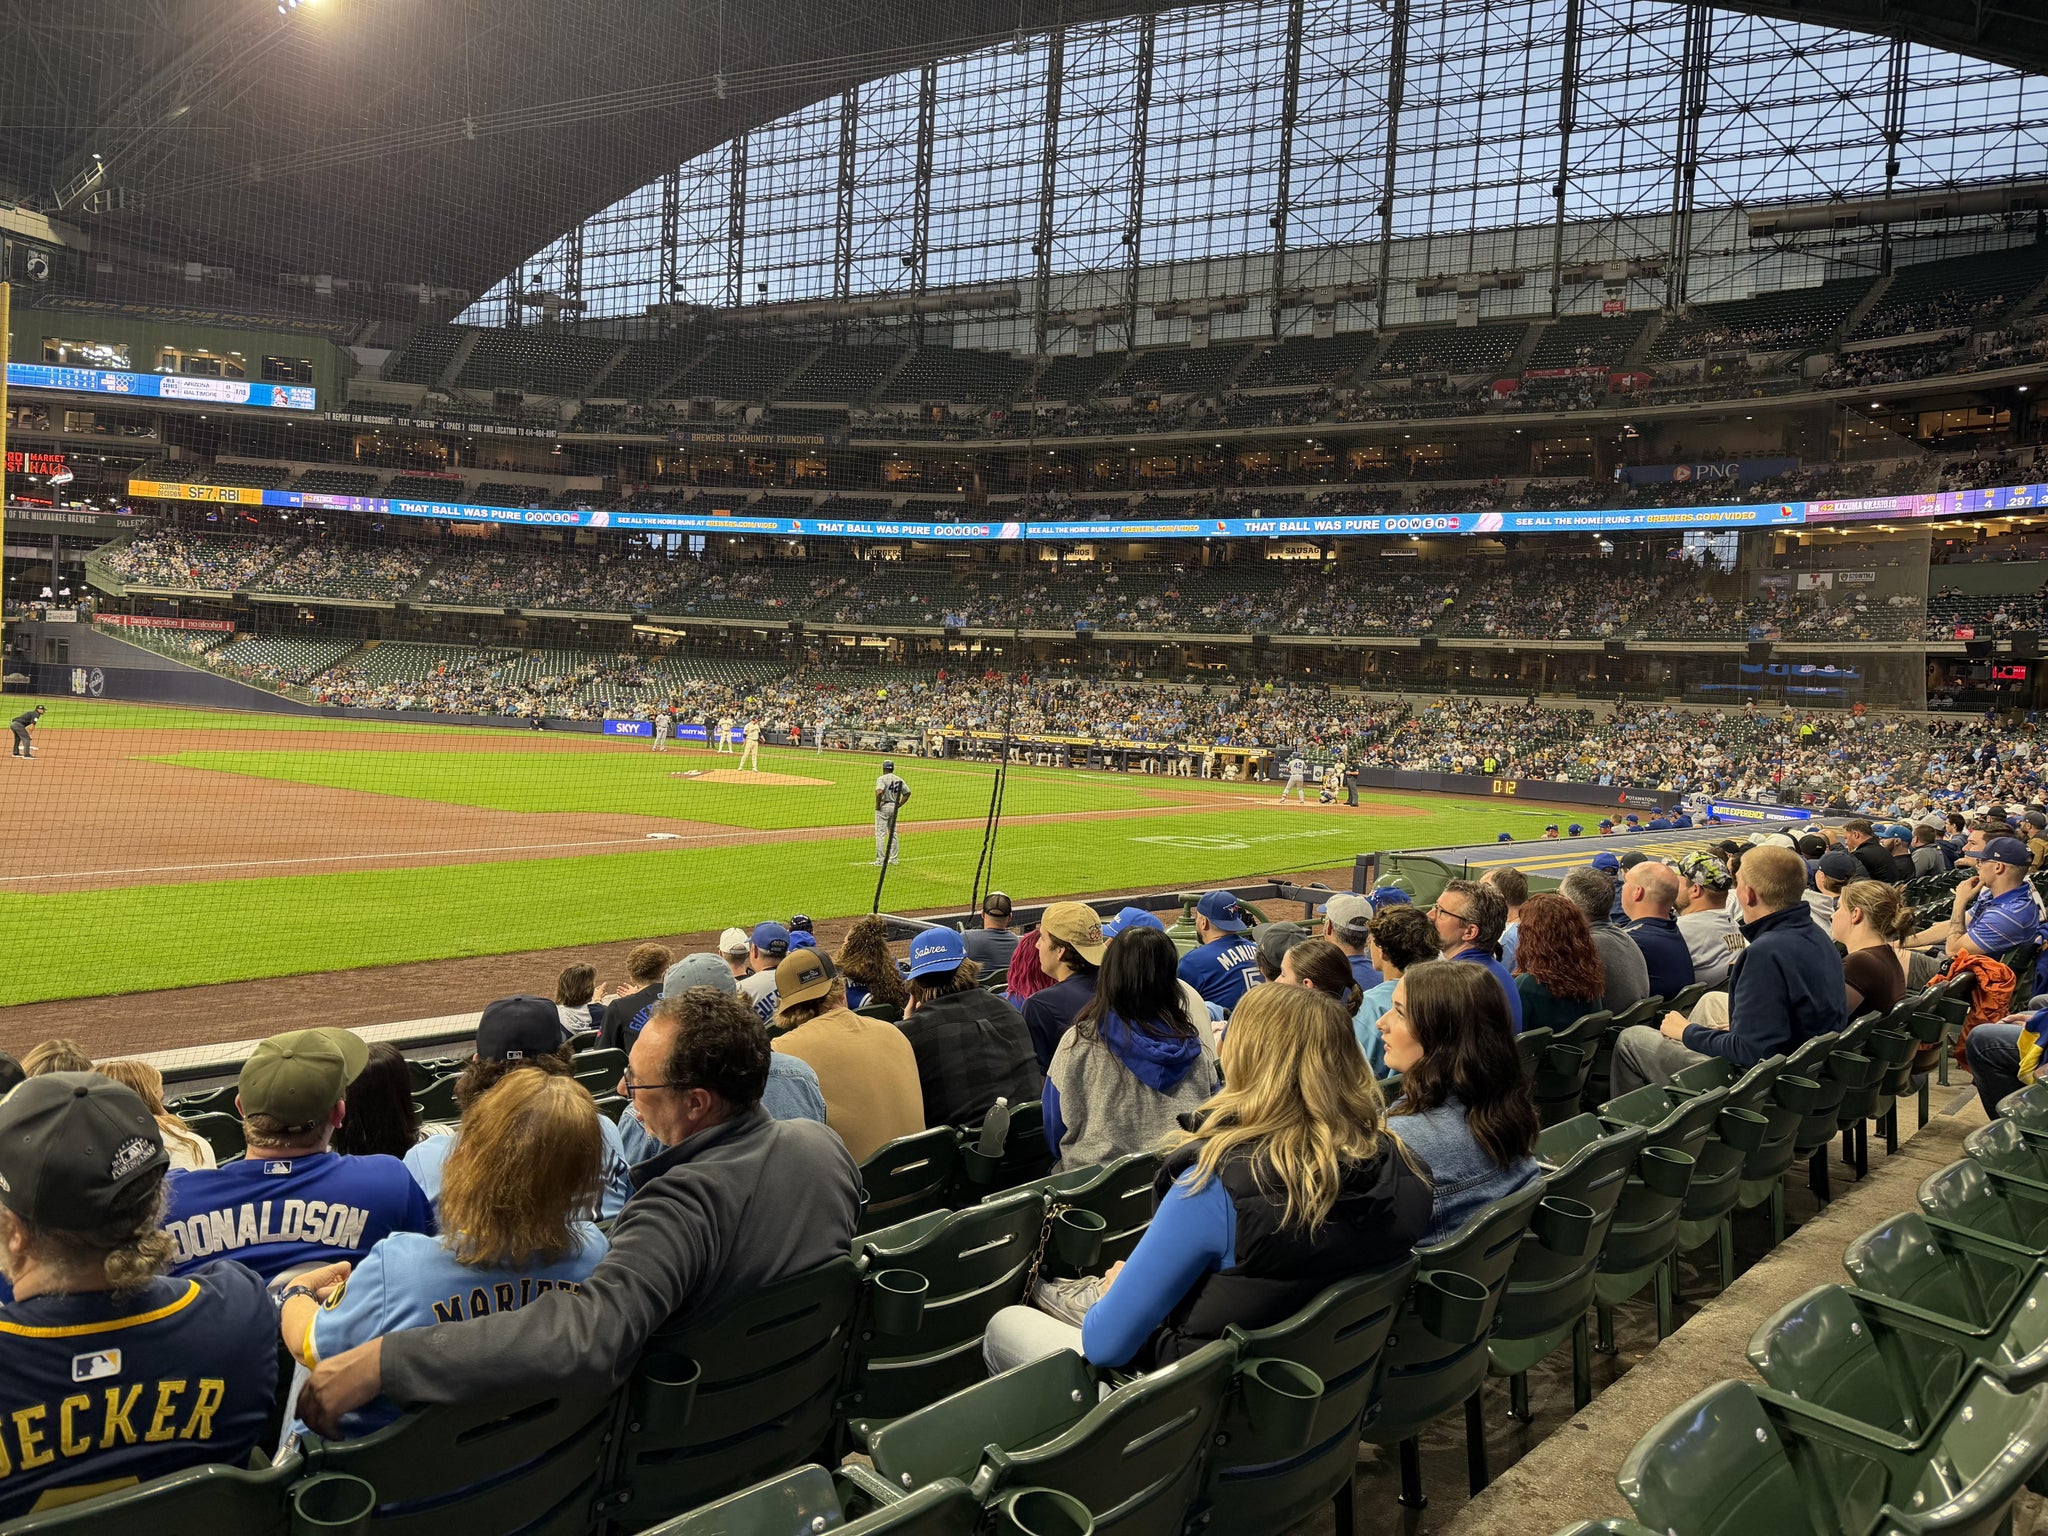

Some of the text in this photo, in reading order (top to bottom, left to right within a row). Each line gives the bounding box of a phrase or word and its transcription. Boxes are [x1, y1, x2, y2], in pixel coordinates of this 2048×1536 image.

[62, 299, 119, 310] MUST
[124, 304, 149, 312] BE
[152, 307, 176, 315] IN
[178, 309, 218, 319] THE
[220, 313, 288, 326] FRONT
[183, 390, 217, 398] BALTIMORE
[332, 413, 351, 422] REPORT
[352, 413, 362, 422] FAN
[398, 417, 410, 427] TEXT
[468, 423, 482, 432] ISSUE
[484, 424, 494, 433] AND
[495, 424, 517, 436] LOCATION
[692, 433, 824, 444] BREWERS COMMUNITY FOUNDATION
[30, 453, 65, 463] MARKET
[1696, 464, 1739, 480] PNC
[158, 483, 181, 491] SCORING
[219, 489, 240, 502] RBI
[1834, 500, 1862, 512] KAZUMA
[1955, 503, 1963, 511] 2
[1984, 501, 1992, 509] 4
[2006, 496, 2033, 507] .297
[9, 511, 17, 519] OF
[19, 511, 29, 520] THE
[31, 512, 66, 522] MILWAUKEE
[399, 503, 569, 523] THAT BALL WAS PURE POWER
[1516, 512, 1756, 526] SEE ALL THE HOME RUNS AT BREWERS.COM/VIDEO
[817, 523, 980, 536] THAT BALL WAS PURE POWER
[1245, 522, 1276, 532] THAT
[1279, 521, 1310, 531] BALL
[1314, 520, 1342, 530] WAS
[1345, 519, 1380, 530] PURE
[1386, 518, 1446, 528] POWER
[130, 616, 152, 627] family
[152, 617, 178, 627] section
[198, 621, 224, 630] alcohol
[617, 723, 641, 733] SKYY
[889, 780, 903, 793] 42
[1713, 806, 1730, 815] SUITE
[1731, 807, 1765, 820] EXPERIENCE
[915, 945, 948, 959] Sabres
[112, 1143, 157, 1181] POSTSEASON
[165, 1199, 370, 1264] DONALDSON
